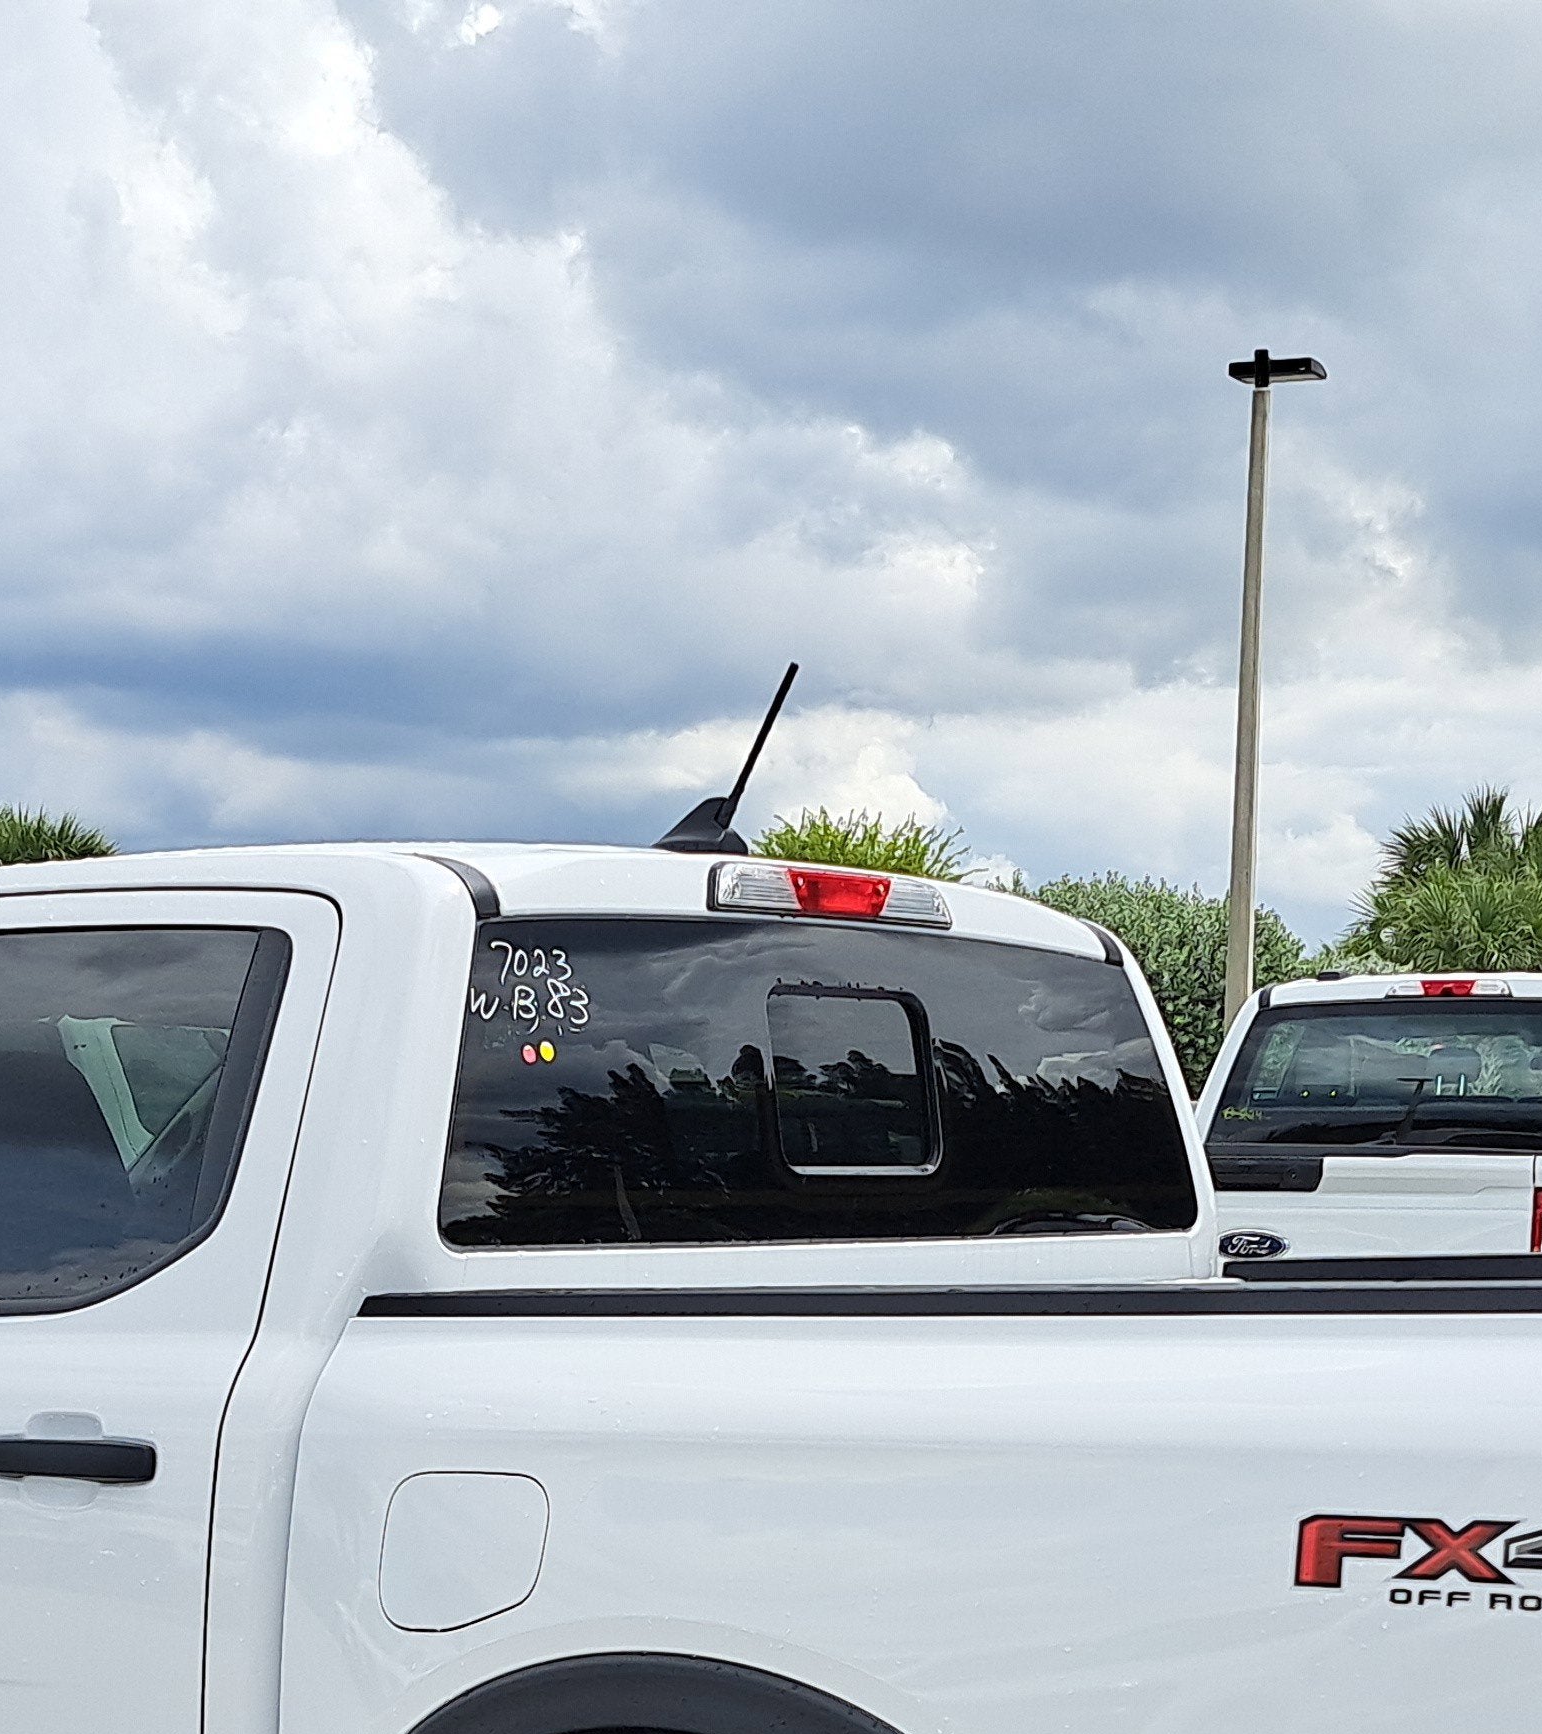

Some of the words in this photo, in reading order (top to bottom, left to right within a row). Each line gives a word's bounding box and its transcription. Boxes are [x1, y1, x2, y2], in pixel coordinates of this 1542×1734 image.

[490, 941, 572, 985] 7023
[1227, 1236, 1271, 1254] Ford
[1389, 1588, 1471, 1607] OFF
